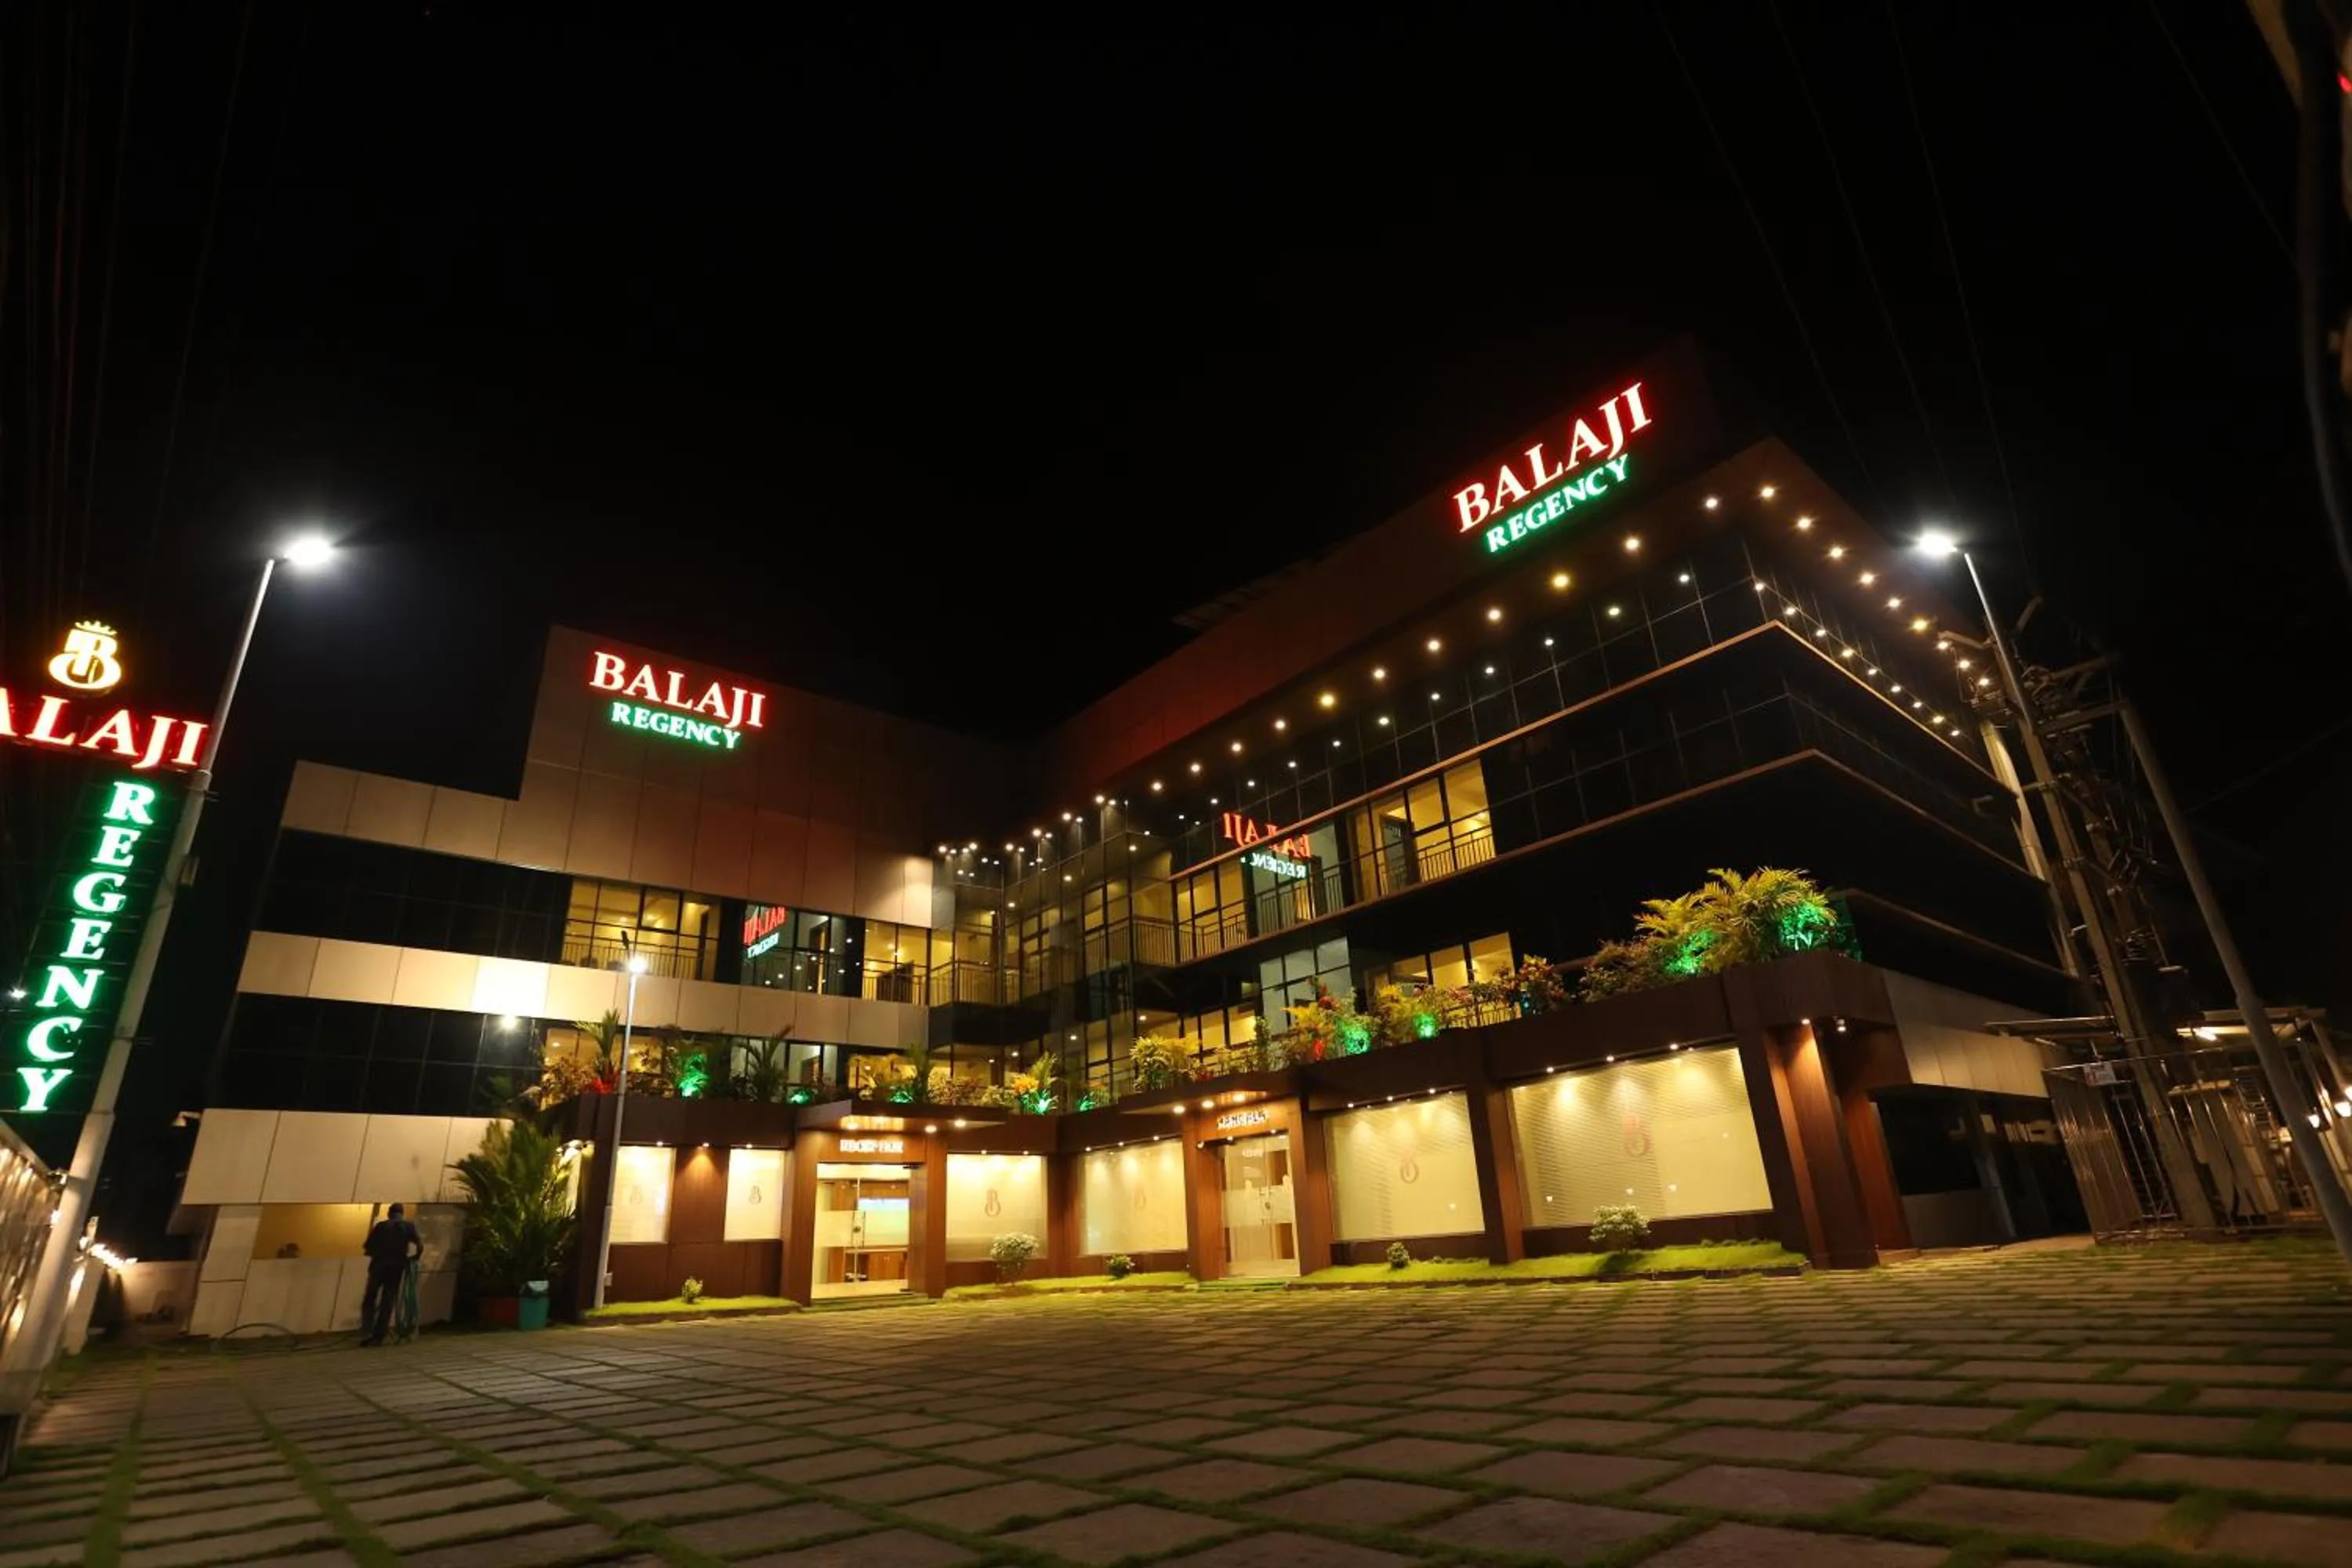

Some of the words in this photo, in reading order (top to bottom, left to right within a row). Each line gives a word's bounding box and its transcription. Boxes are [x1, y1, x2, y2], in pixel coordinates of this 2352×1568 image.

[1453, 382, 1652, 533] BALAJI
[1486, 452, 1628, 553] REGENCY
[590, 652, 766, 728] BALAJI
[611, 702, 741, 750] REGENCY
[17, 781, 156, 1112] REGENCY
